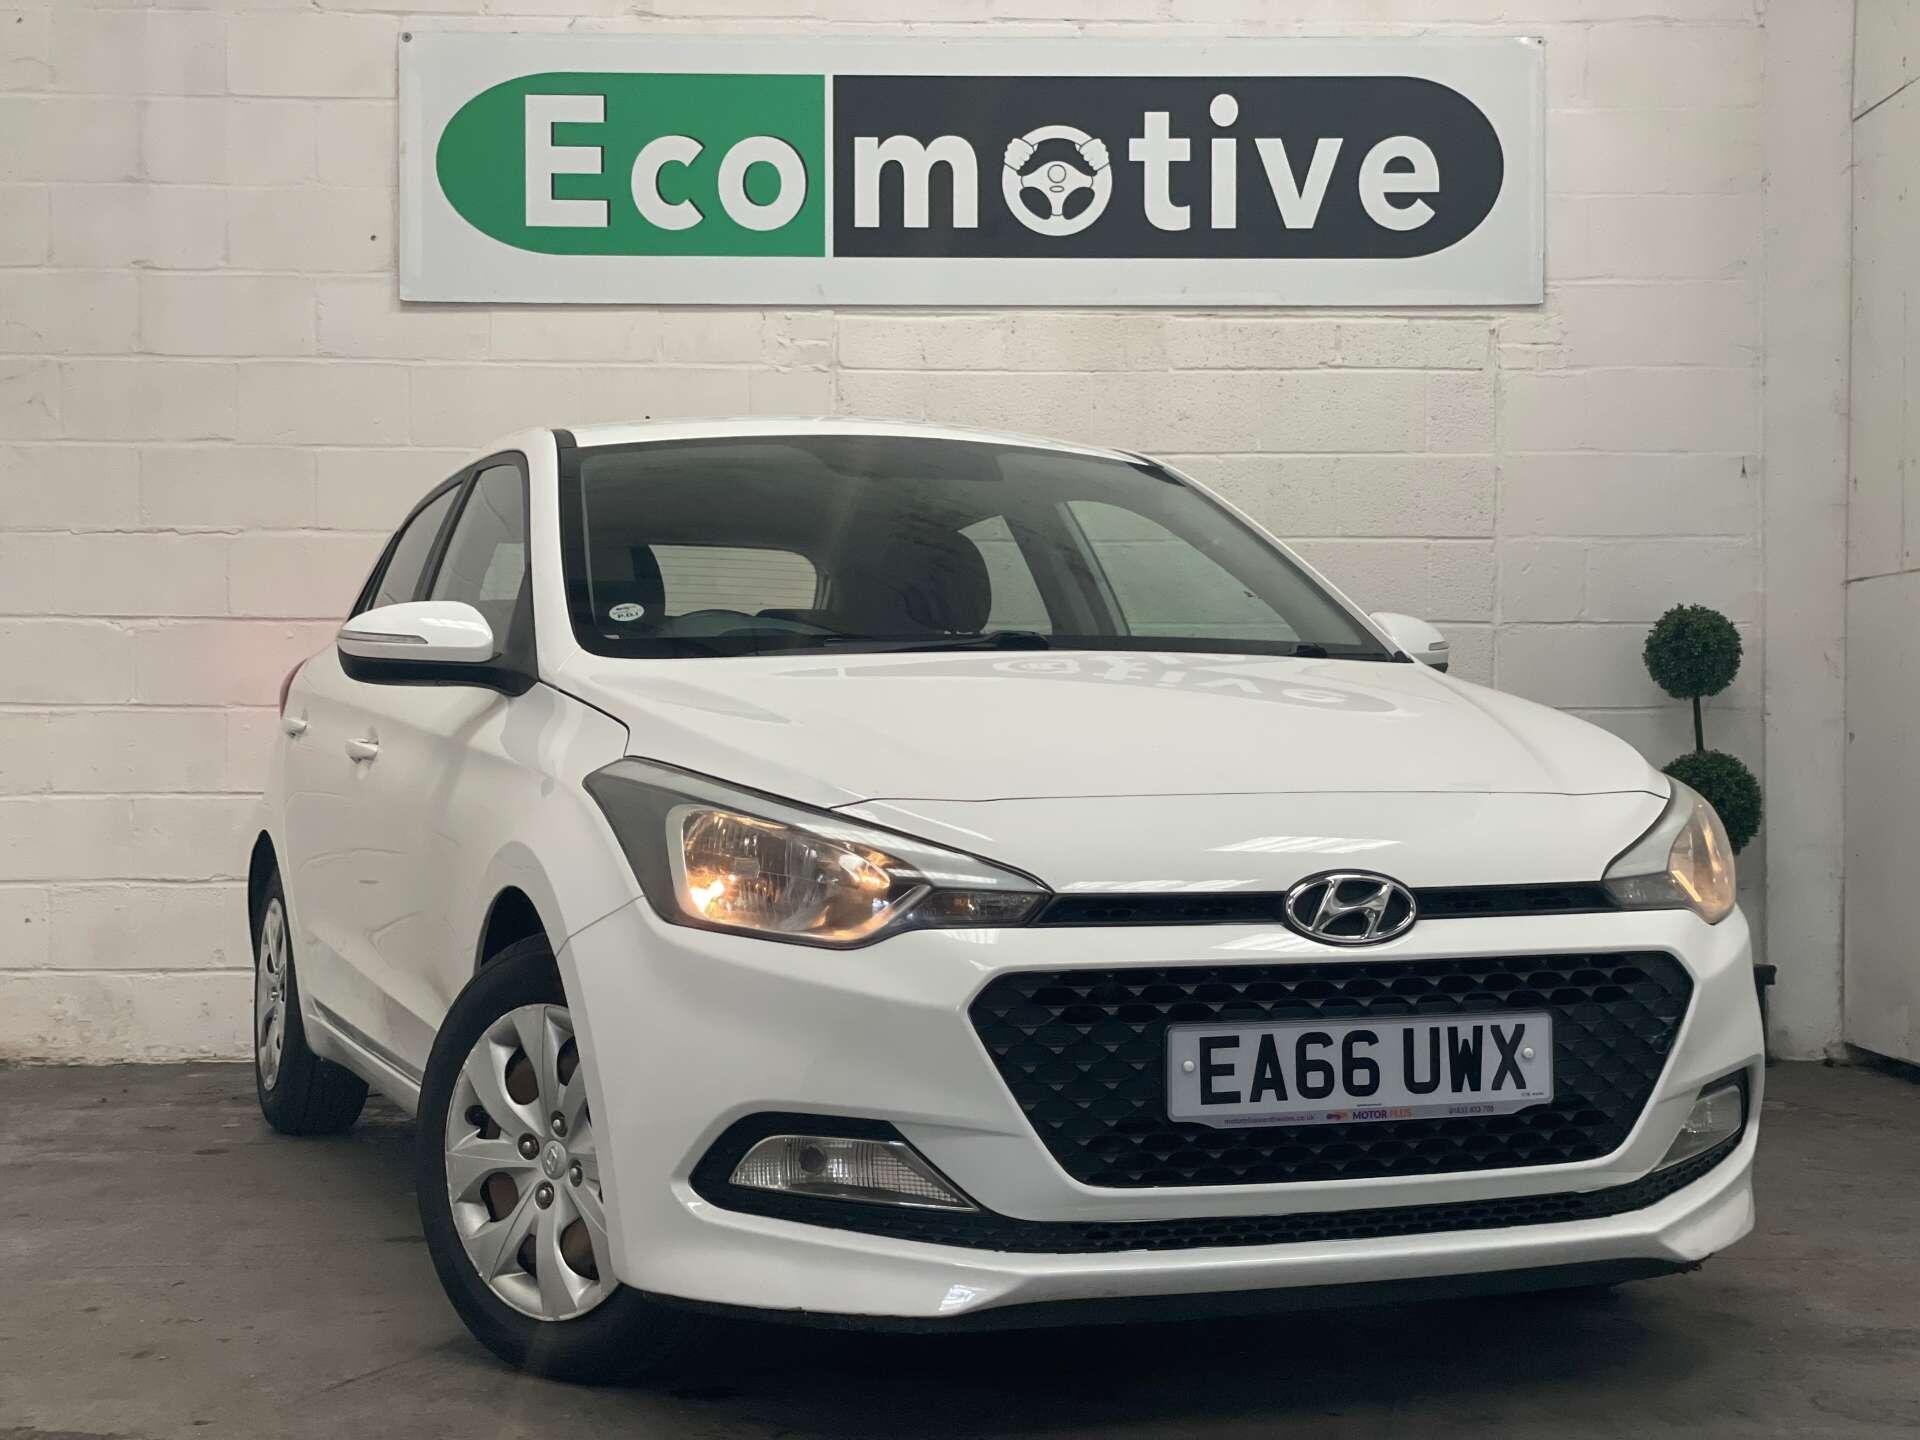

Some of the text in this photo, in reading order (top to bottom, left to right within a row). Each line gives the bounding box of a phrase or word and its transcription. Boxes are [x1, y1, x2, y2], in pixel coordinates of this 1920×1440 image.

[1199, 1023, 1527, 1106] EA66 UWX
[1352, 1109, 1387, 1120] MOTOR
